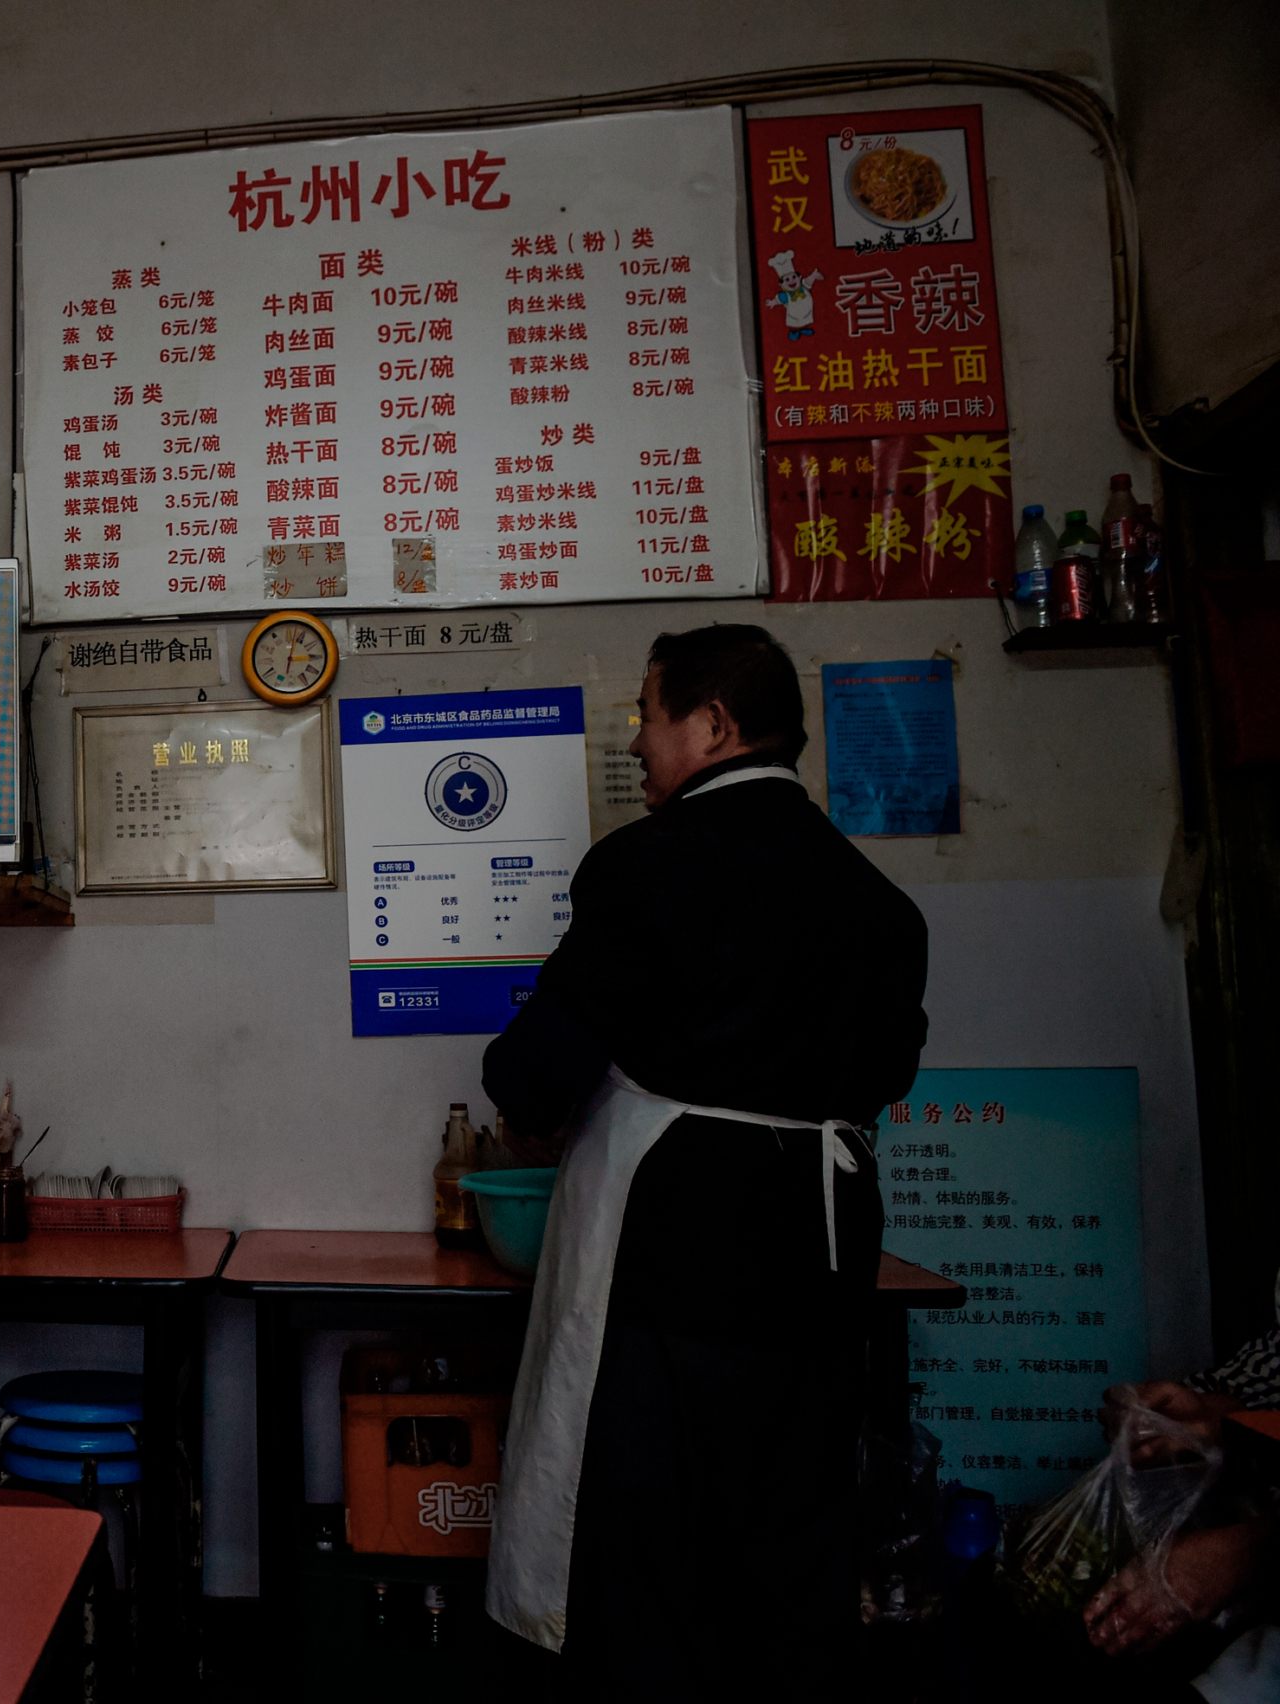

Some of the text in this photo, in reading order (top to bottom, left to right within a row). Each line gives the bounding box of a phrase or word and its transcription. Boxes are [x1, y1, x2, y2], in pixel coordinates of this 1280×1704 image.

[228, 149, 510, 232] 杭州小吃
[767, 145, 814, 234] 武汉
[505, 255, 691, 284] 牛肉米线 10元/碗
[62, 290, 215, 317] 小笼包 6元/笼
[263, 280, 458, 317] 牛肉面 10元/碗
[507, 286, 687, 315] 肉丝米线 9元/碗
[835, 264, 985, 337] 香辣
[161, 317, 217, 336] 6元/笼
[265, 318, 453, 353] 肉丝面 9元/碗
[507, 316, 688, 345] 酸辣米线 8元/碗
[62, 345, 216, 371] 素包子 6元/笼
[509, 347, 690, 375] 青菜米线 8元/碗
[773, 344, 989, 393] 红油热干面
[264, 356, 454, 390] 鸡蛋面 9元/碗
[510, 377, 694, 405] 酸辣粉 8元/碗
[63, 407, 217, 433] 鸡蛋汤 3元/碗
[265, 393, 455, 427] 炸酱面 9元/碗
[774, 395, 996, 428] （有辣和不辣两种口味）
[163, 435, 220, 454] 3元/碗
[266, 431, 457, 465] 热干面 8元/碗
[495, 446, 702, 475] 蛋炒饭 9元/盘
[64, 462, 236, 488] 紫菜鸡蛋汤 3.5元/碗
[266, 469, 459, 502] 酸辣面 8元/碗
[64, 489, 238, 516] 紫菜馄饨 3.5元/碗
[495, 475, 705, 504] 鸡蛋炒米线 11元/盘
[165, 517, 238, 537] 1.5元/碗
[268, 508, 460, 540] 青菜面 8元/碗
[497, 504, 709, 533] 素炒米线 10元/盘
[498, 534, 710, 561] 鸡蛋炒面 11元/盘
[794, 506, 982, 563] 酸辣粉
[64, 546, 226, 571] 紫菜汤 2元/碗
[64, 574, 226, 599] 水汤饺 9元/碗
[499, 562, 714, 591] 素炒面 10元/盘
[355, 621, 513, 649] 热干面 8 元/盘
[68, 637, 213, 668] 谢绝自带食品
[390, 705, 560, 726] 北京市东城区食品药品监督管理局
[152, 739, 250, 766] 营业执照
[458, 755, 471, 770] C
[433, 802, 499, 828] 量化分级评定等级
[378, 862, 411, 872] 场所等级
[495, 858, 529, 868] 管理等级
[441, 897, 458, 906] 优秀
[552, 893, 569, 902] 优秀
[442, 915, 459, 924] 良好
[553, 911, 570, 921] 良好
[443, 935, 460, 944] 一般
[399, 996, 439, 1007] 12331
[889, 1101, 1006, 1125] 服务公约
[939, 1262, 1104, 1278] 各类用具清洁卫生，保持
[966, 1286, 1023, 1301] 容整洁。
[907, 1310, 1106, 1326] ，规范从业人员的行为、语言
[909, 1406, 1099, 1423] 部门管理，自觉接受社会各
